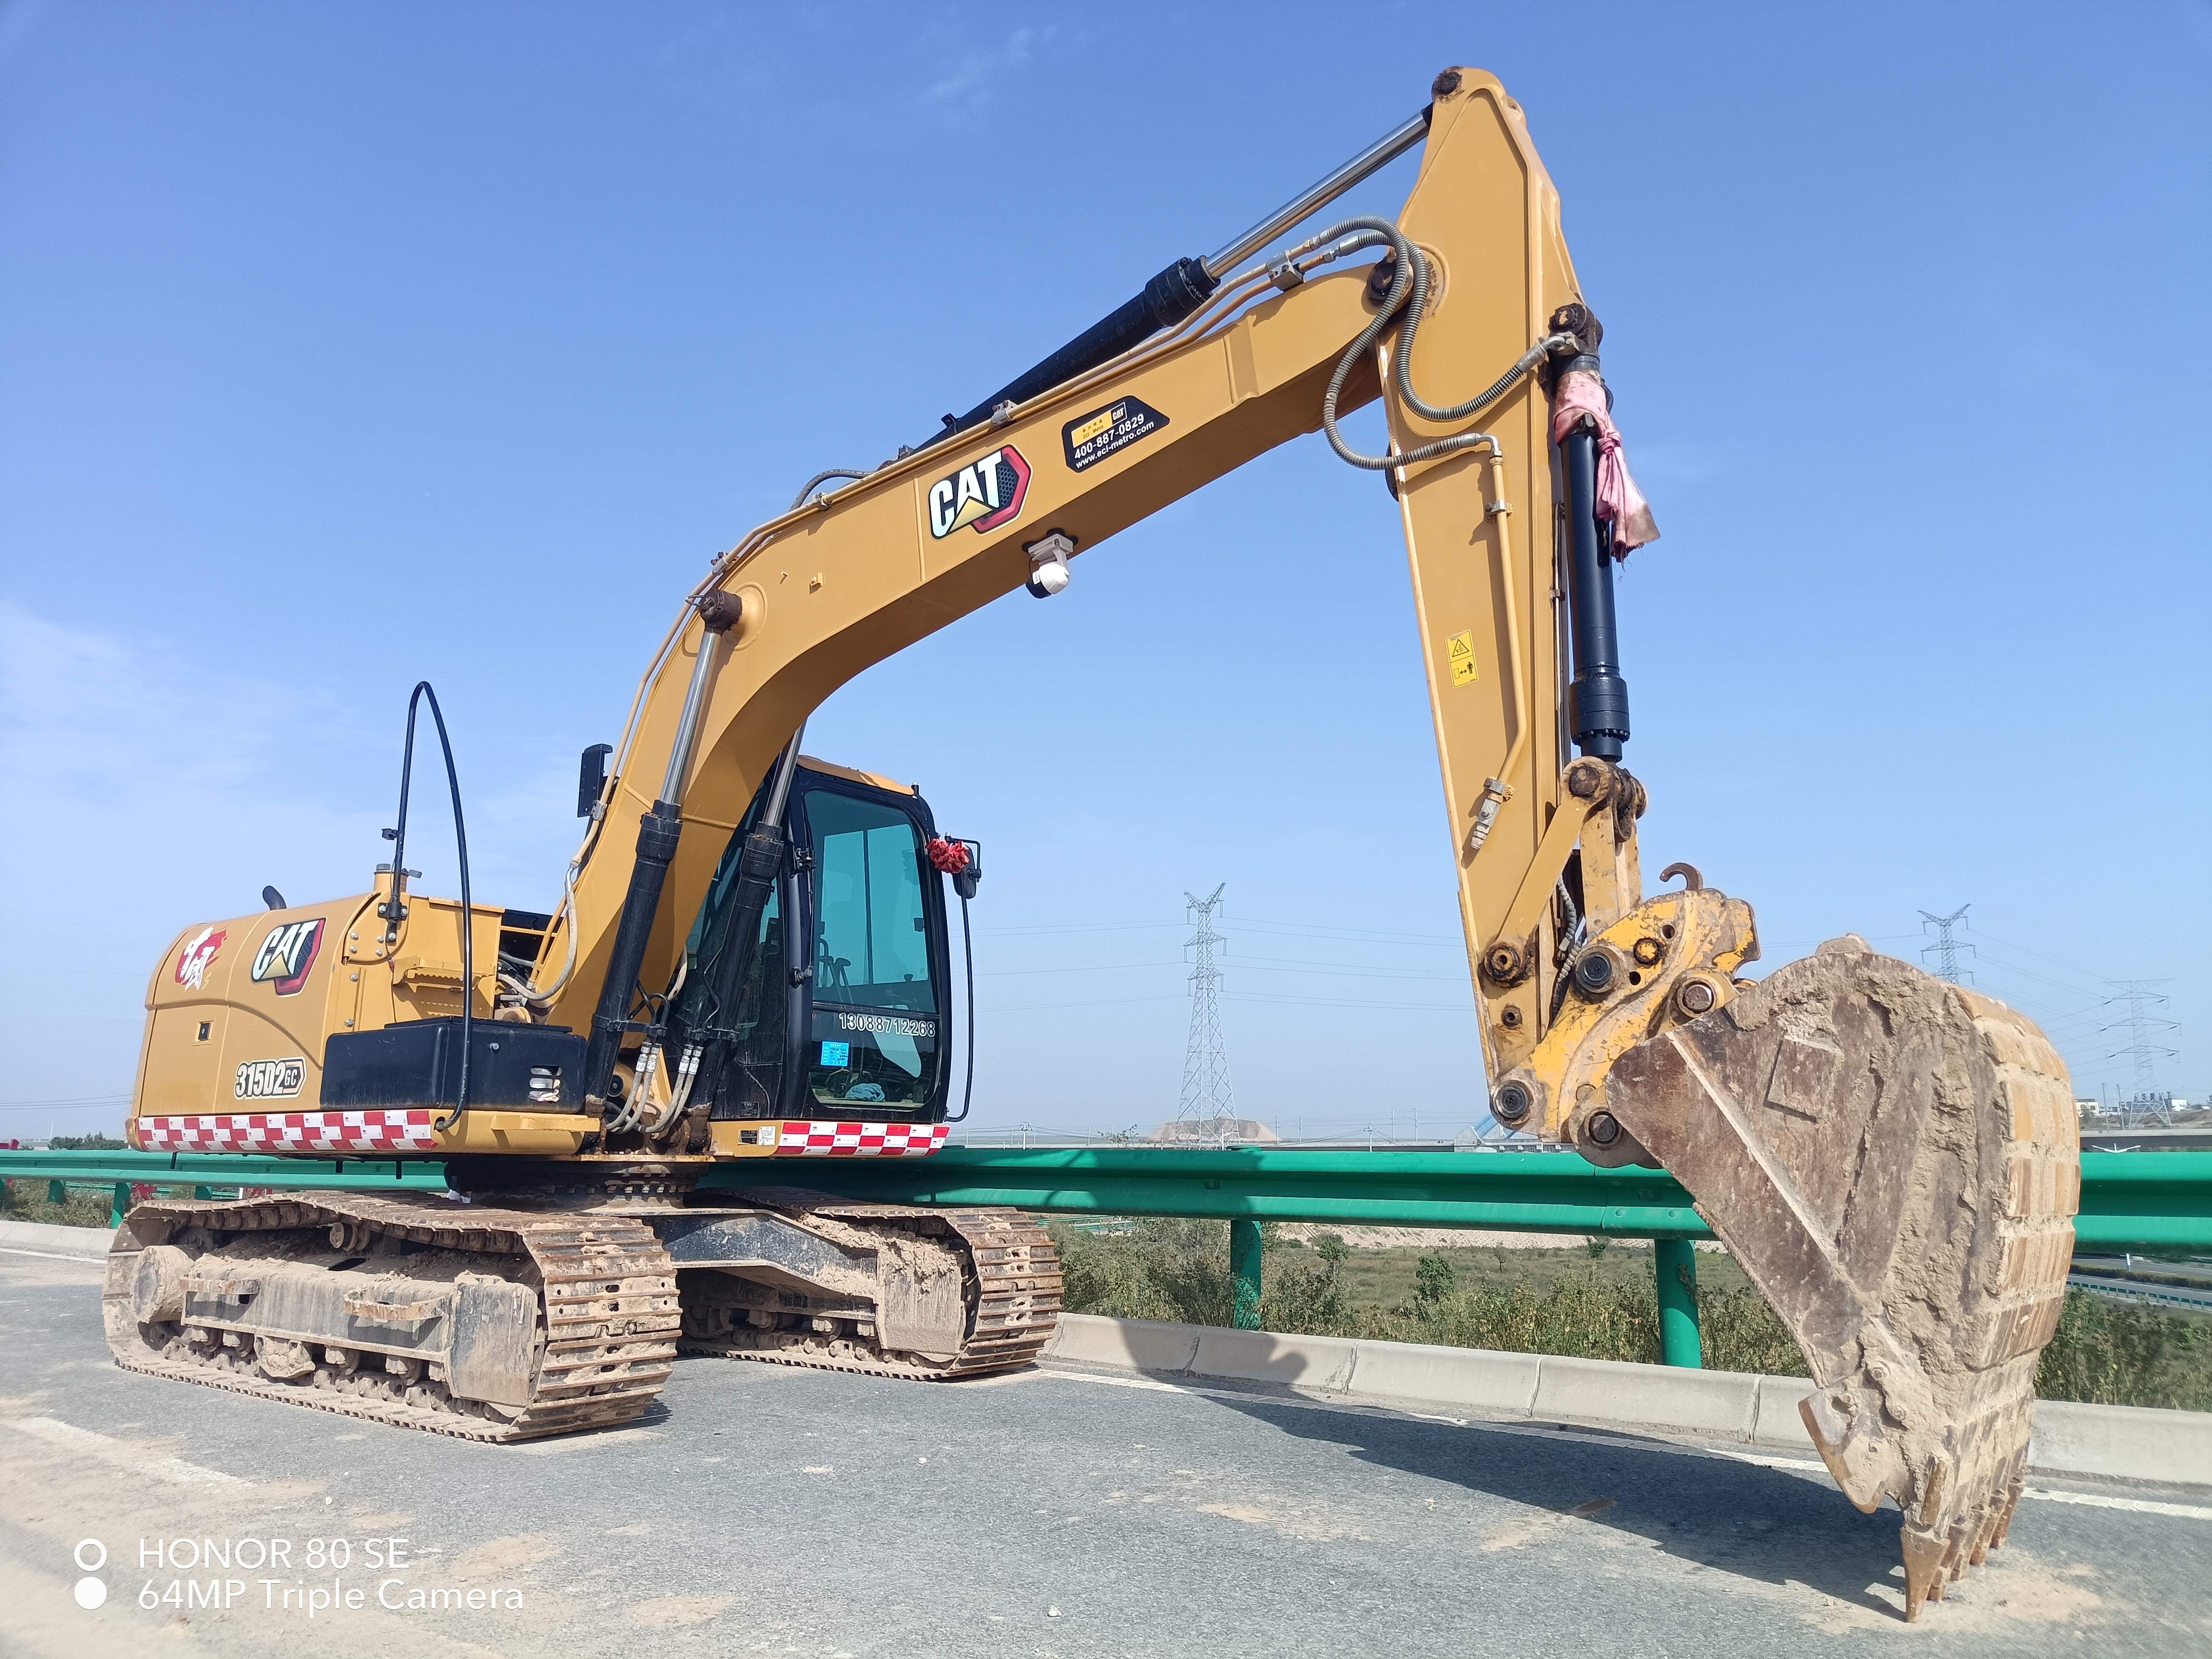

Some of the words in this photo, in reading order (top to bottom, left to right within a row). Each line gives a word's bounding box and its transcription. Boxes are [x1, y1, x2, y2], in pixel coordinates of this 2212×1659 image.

[1074, 413, 1144, 459] 400-887-0829
[1113, 408, 1124, 420] CAT
[1076, 421, 1154, 469] www.eci-metro.com
[929, 450, 1002, 537] CAT
[252, 920, 319, 980] CAT
[839, 1013, 935, 1037] 13088712268
